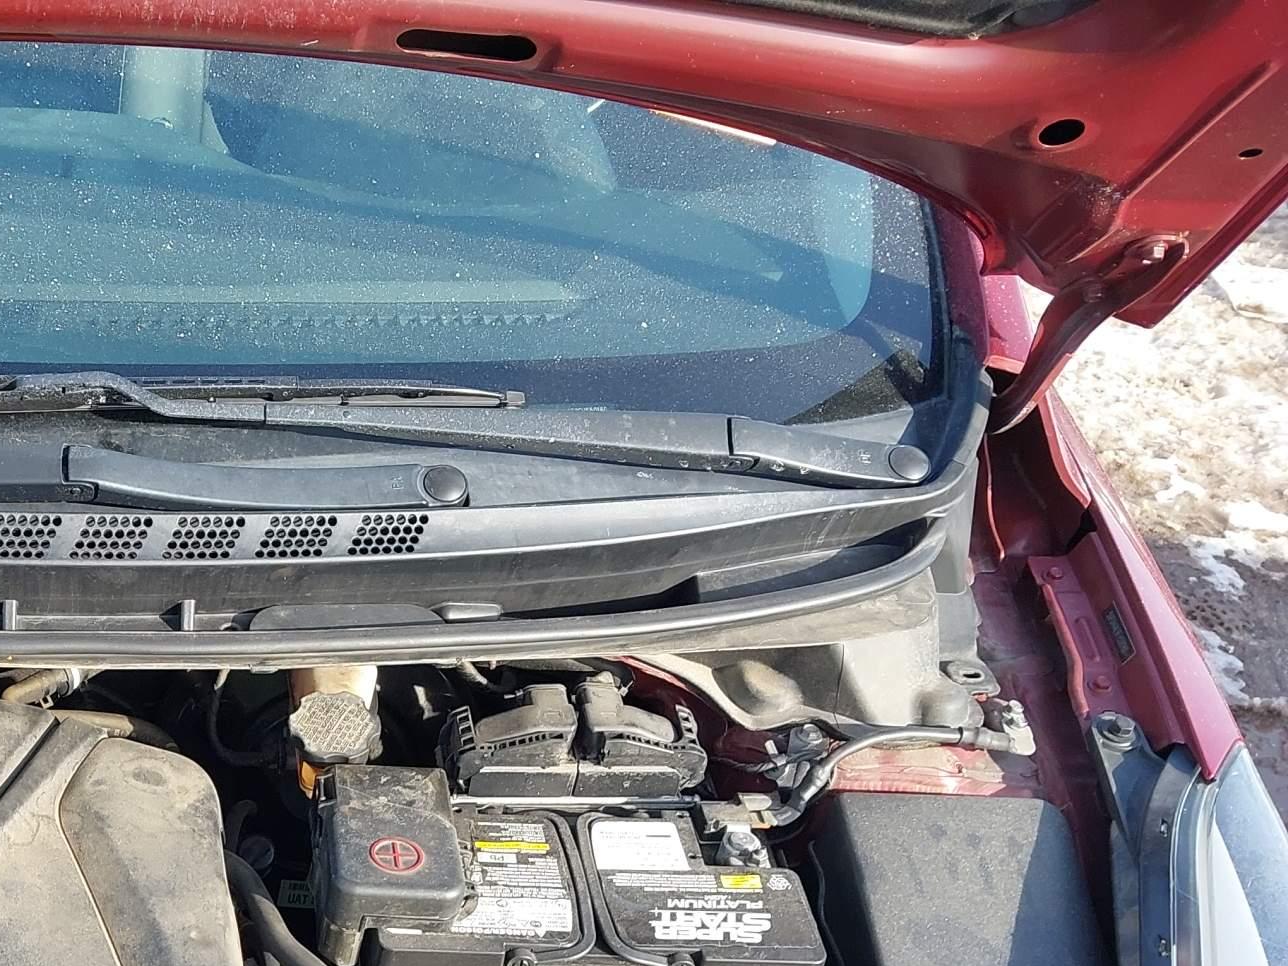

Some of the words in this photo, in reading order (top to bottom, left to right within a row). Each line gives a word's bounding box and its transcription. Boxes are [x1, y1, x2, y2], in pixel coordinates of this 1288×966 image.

[667, 898, 763, 909] PLATINUM
[649, 909, 772, 932] START
[654, 925, 763, 944] SUPER
